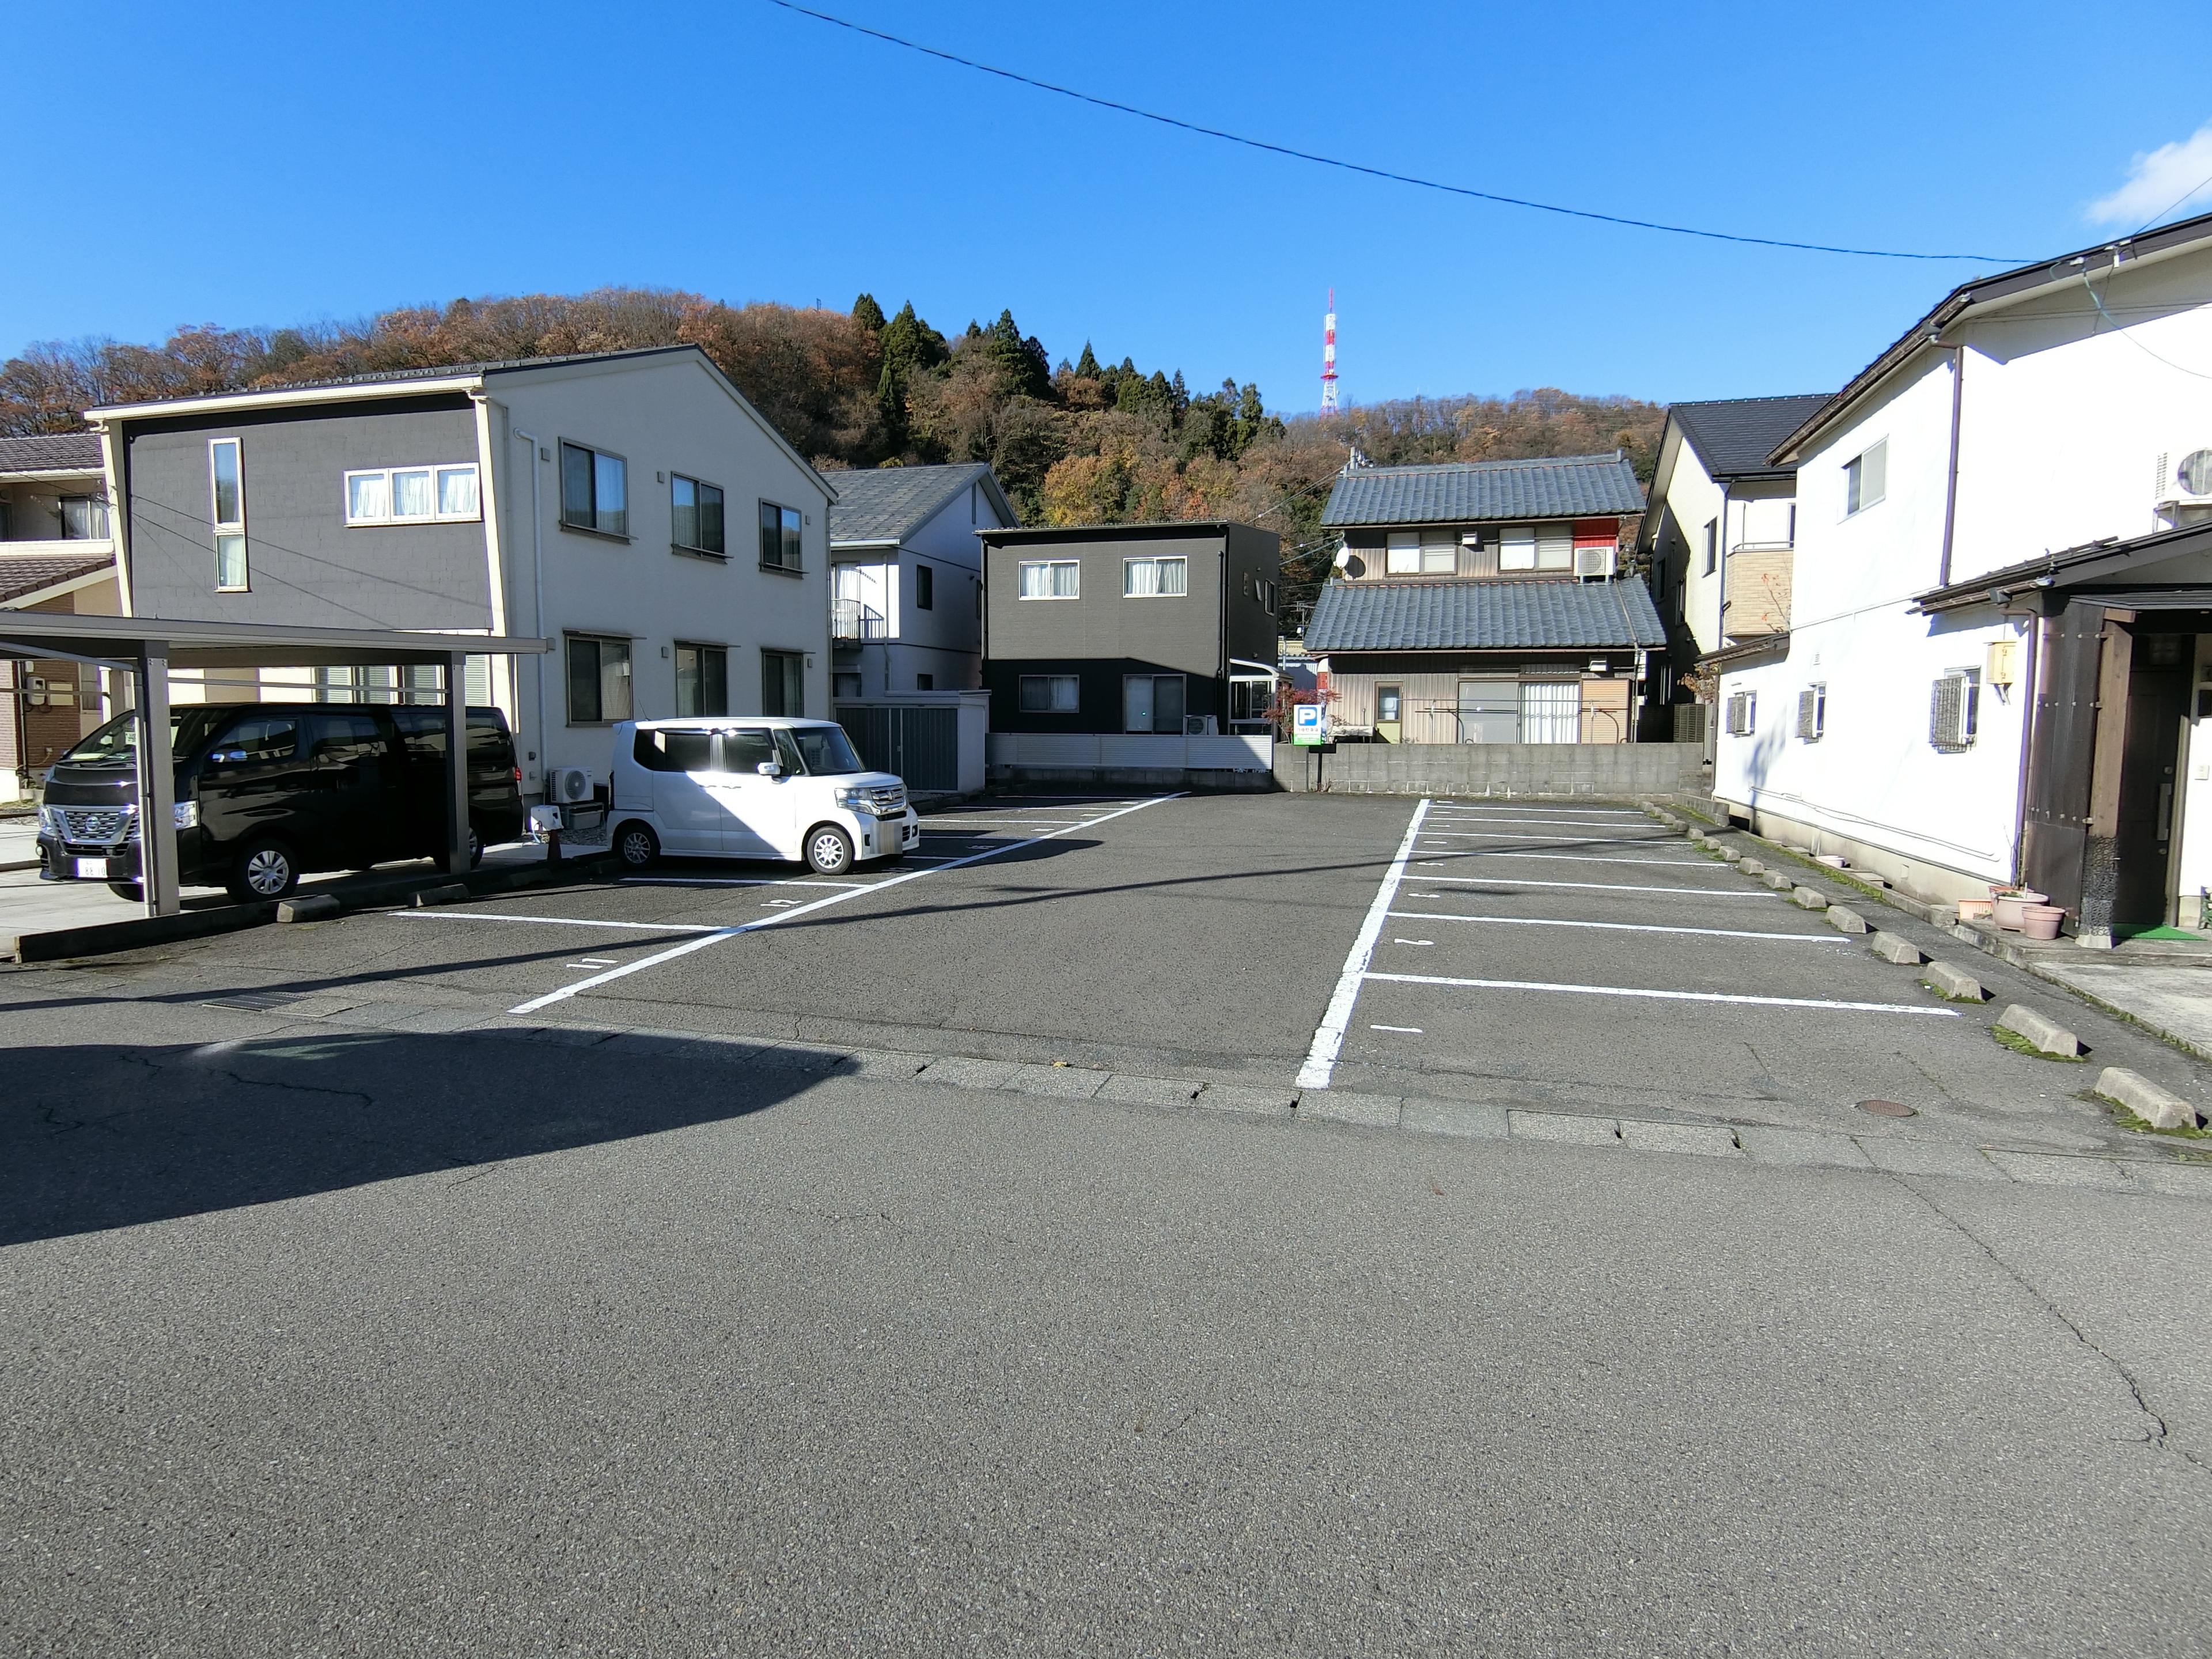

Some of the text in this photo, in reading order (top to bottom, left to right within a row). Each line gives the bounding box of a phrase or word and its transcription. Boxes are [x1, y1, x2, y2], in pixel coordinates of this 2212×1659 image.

[1299, 709, 1316, 724] P
[760, 899, 804, 908] 12
[566, 958, 619, 969] 11
[1370, 1024, 1423, 1033] 1
